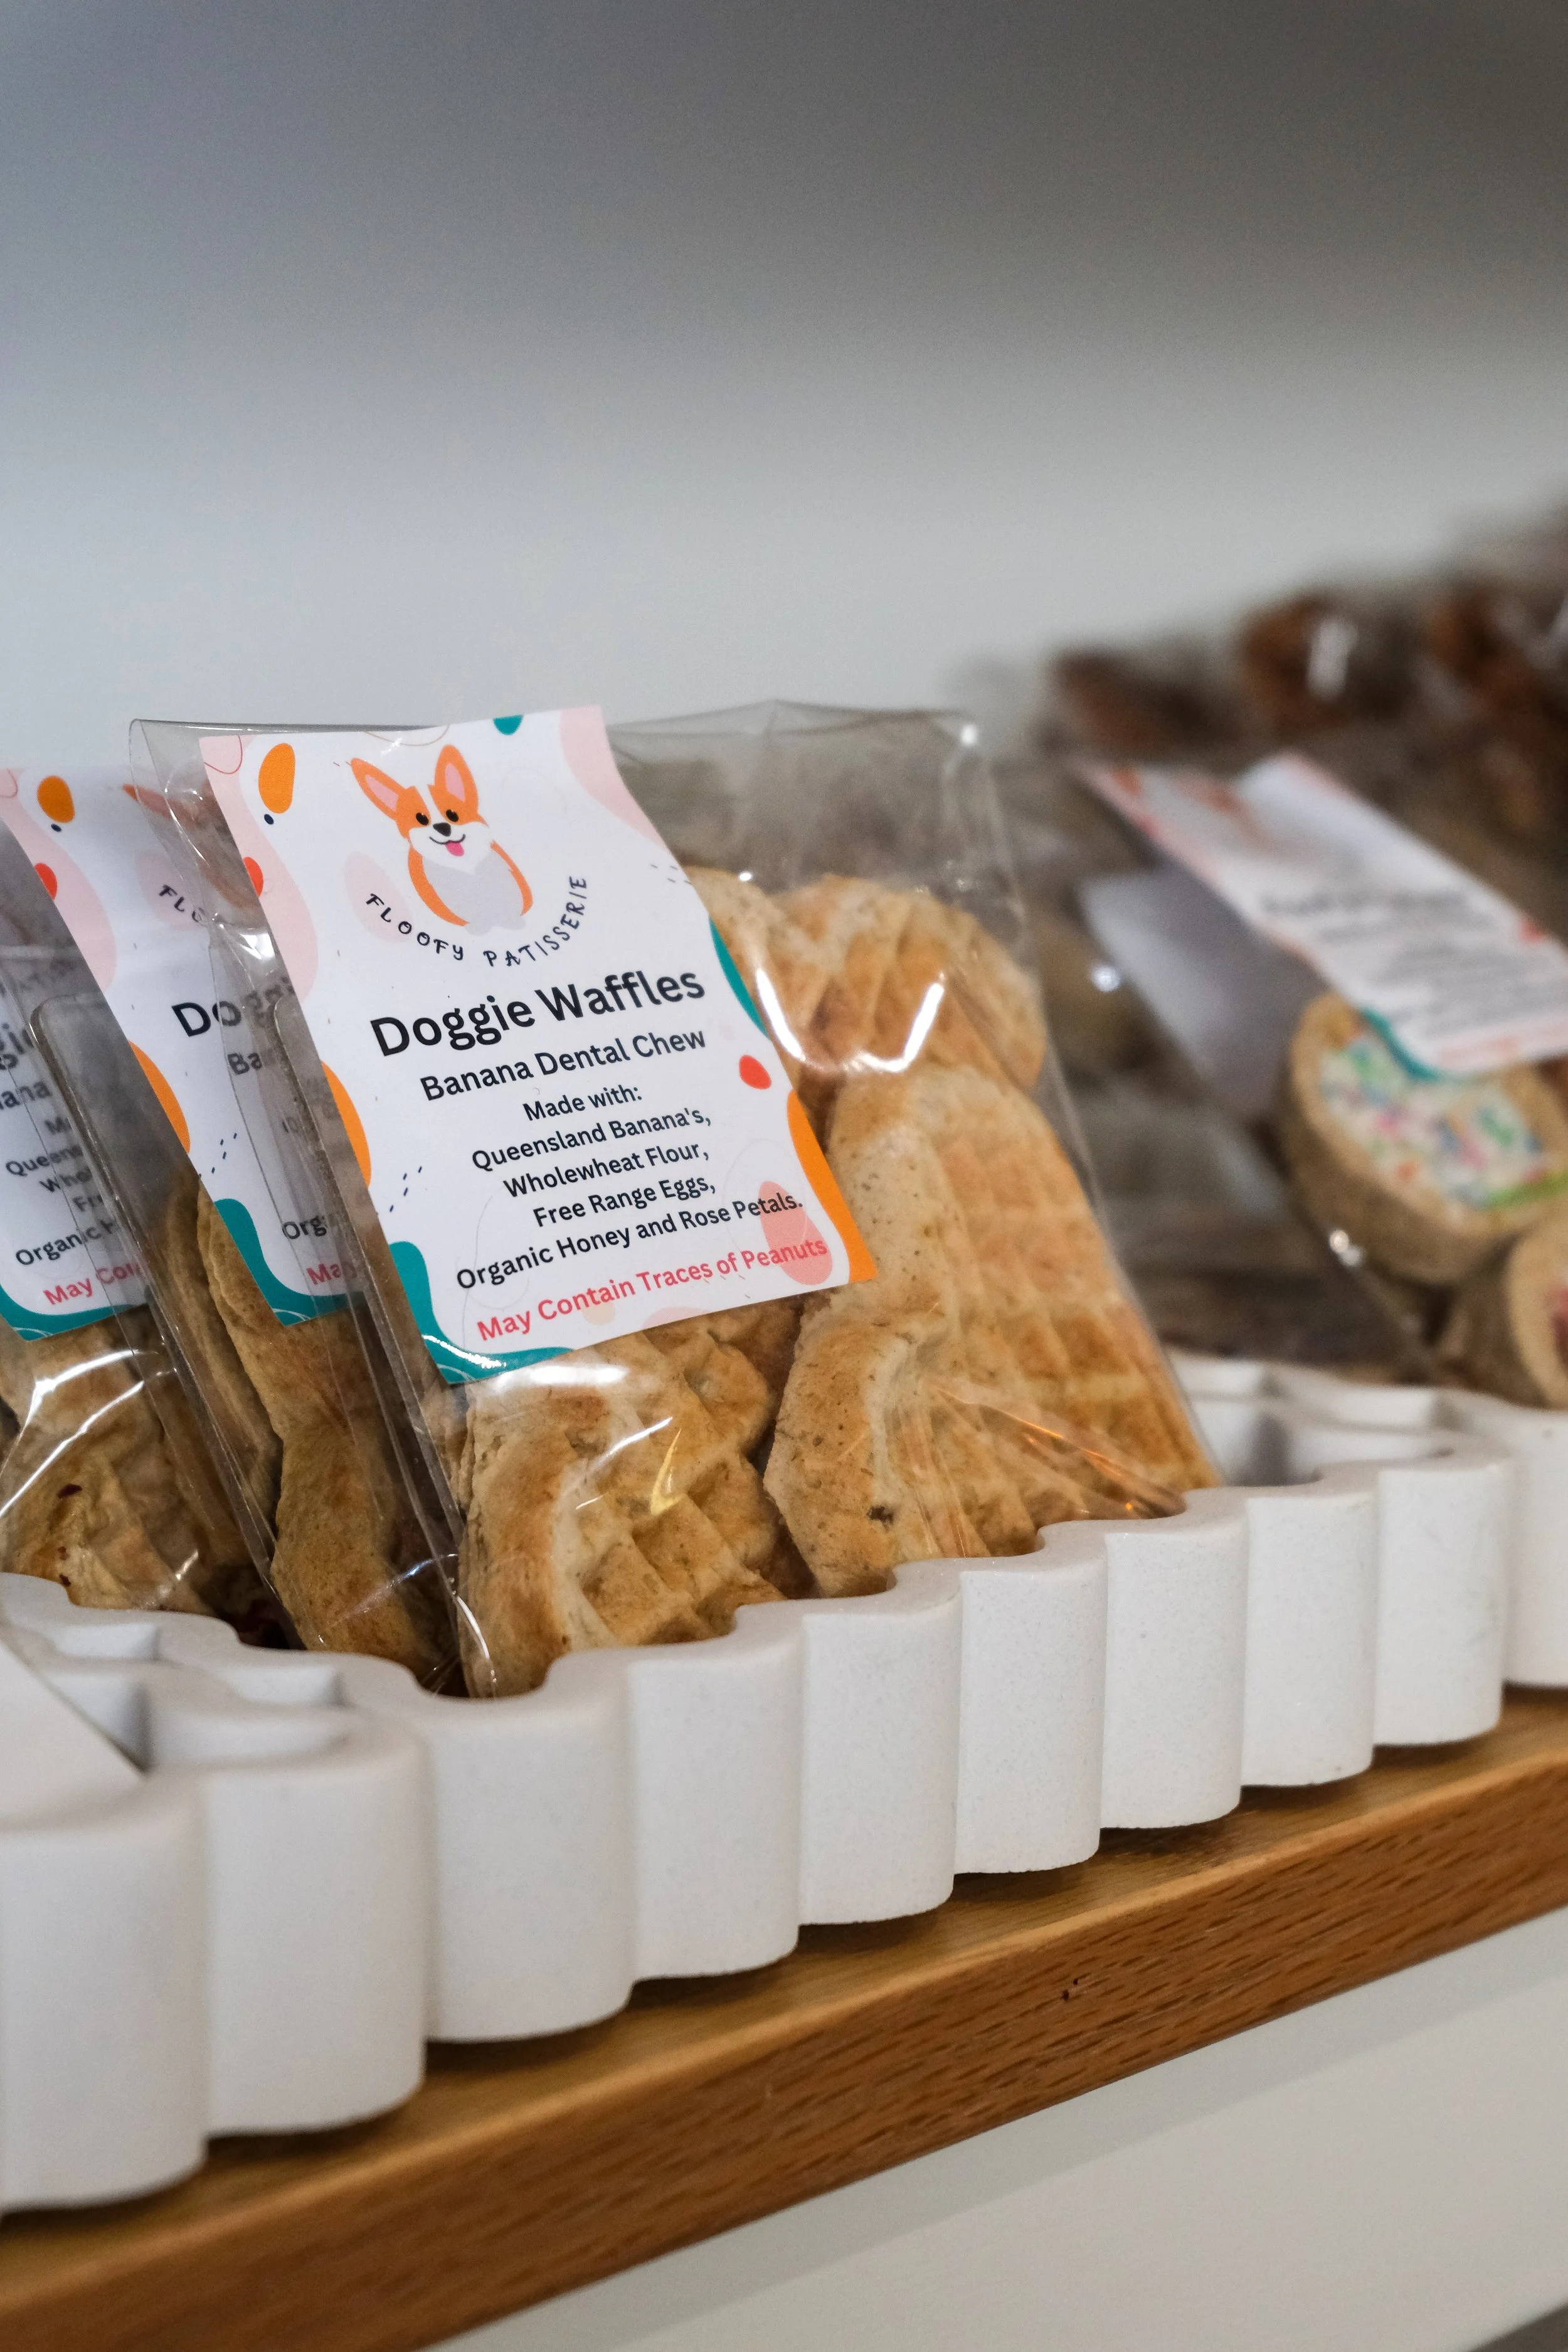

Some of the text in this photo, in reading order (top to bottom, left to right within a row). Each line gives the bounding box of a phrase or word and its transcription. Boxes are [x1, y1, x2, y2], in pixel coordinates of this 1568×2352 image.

[366, 876, 588, 968] FLOOFY PATISSERIE
[370, 970, 706, 1057] Doggie Waffles
[420, 1030, 706, 1101] Banana Dental Chew
[523, 1083, 643, 1121] Made with:
[471, 1107, 712, 1172] Queensland Banana's,
[503, 1142, 709, 1198] Wholewheat Flour,
[532, 1177, 716, 1227] Free Range Eggs,
[16, 1226, 102, 1265] Organic
[457, 1193, 804, 1290] Organic Honey and Rose Petals.
[43, 1278, 93, 1305] May
[476, 1236, 829, 1341] May Contain Traces of Peanuts
